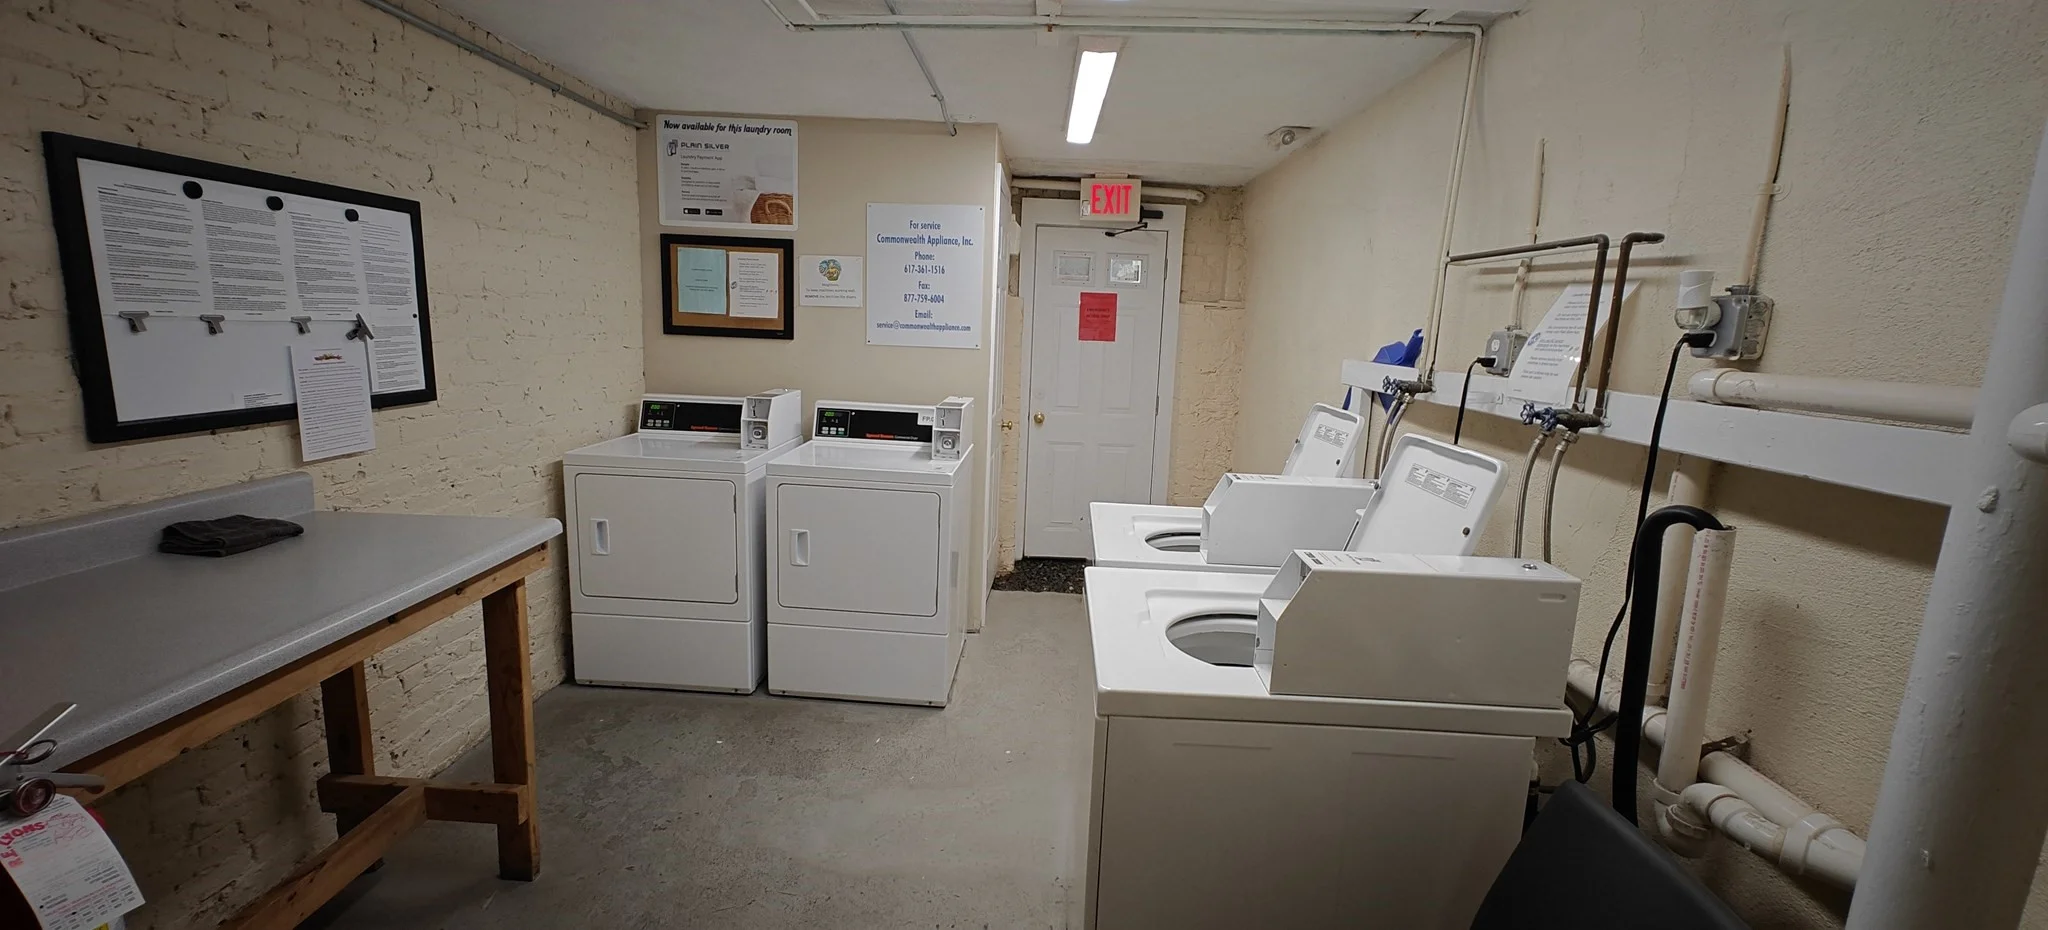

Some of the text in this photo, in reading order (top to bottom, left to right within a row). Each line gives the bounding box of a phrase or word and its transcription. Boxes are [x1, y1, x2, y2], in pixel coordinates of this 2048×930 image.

[664, 120, 792, 136] Now available for this laundry room
[1091, 184, 1132, 215] EXIT
[909, 220, 941, 231] For service
[876, 233, 974, 247] Commonwealth Appliance, Inc.
[914, 251, 935, 261] Phone:
[904, 264, 946, 275] 617-361-1516
[918, 281, 931, 290] Fax:
[903, 294, 945, 304] 877-759-6004
[914, 310, 933, 319] Email:
[876, 320, 972, 333] service@commonwealthappliance.com
